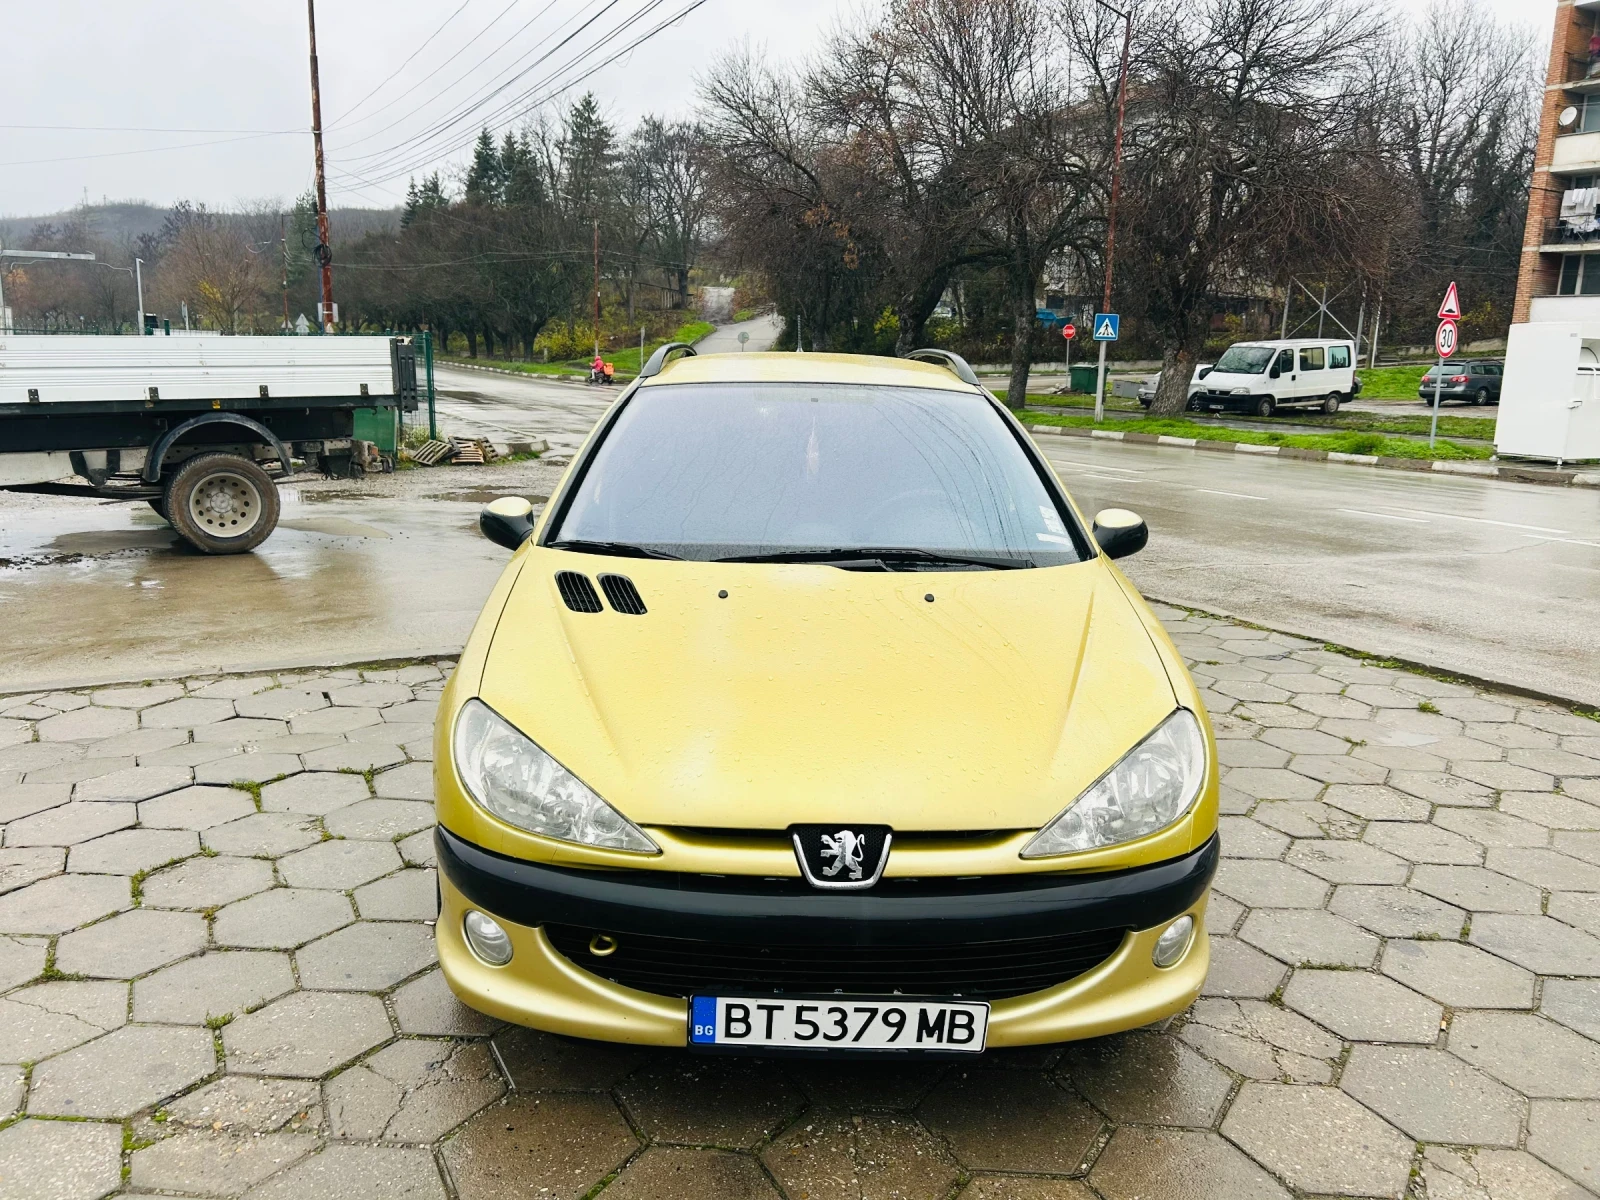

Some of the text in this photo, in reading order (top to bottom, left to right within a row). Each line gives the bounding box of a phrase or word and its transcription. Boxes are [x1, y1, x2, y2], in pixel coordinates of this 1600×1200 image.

[1441, 329, 1453, 348] 30
[694, 1025, 714, 1036] BG
[724, 1003, 975, 1044] BT 5379 MB
